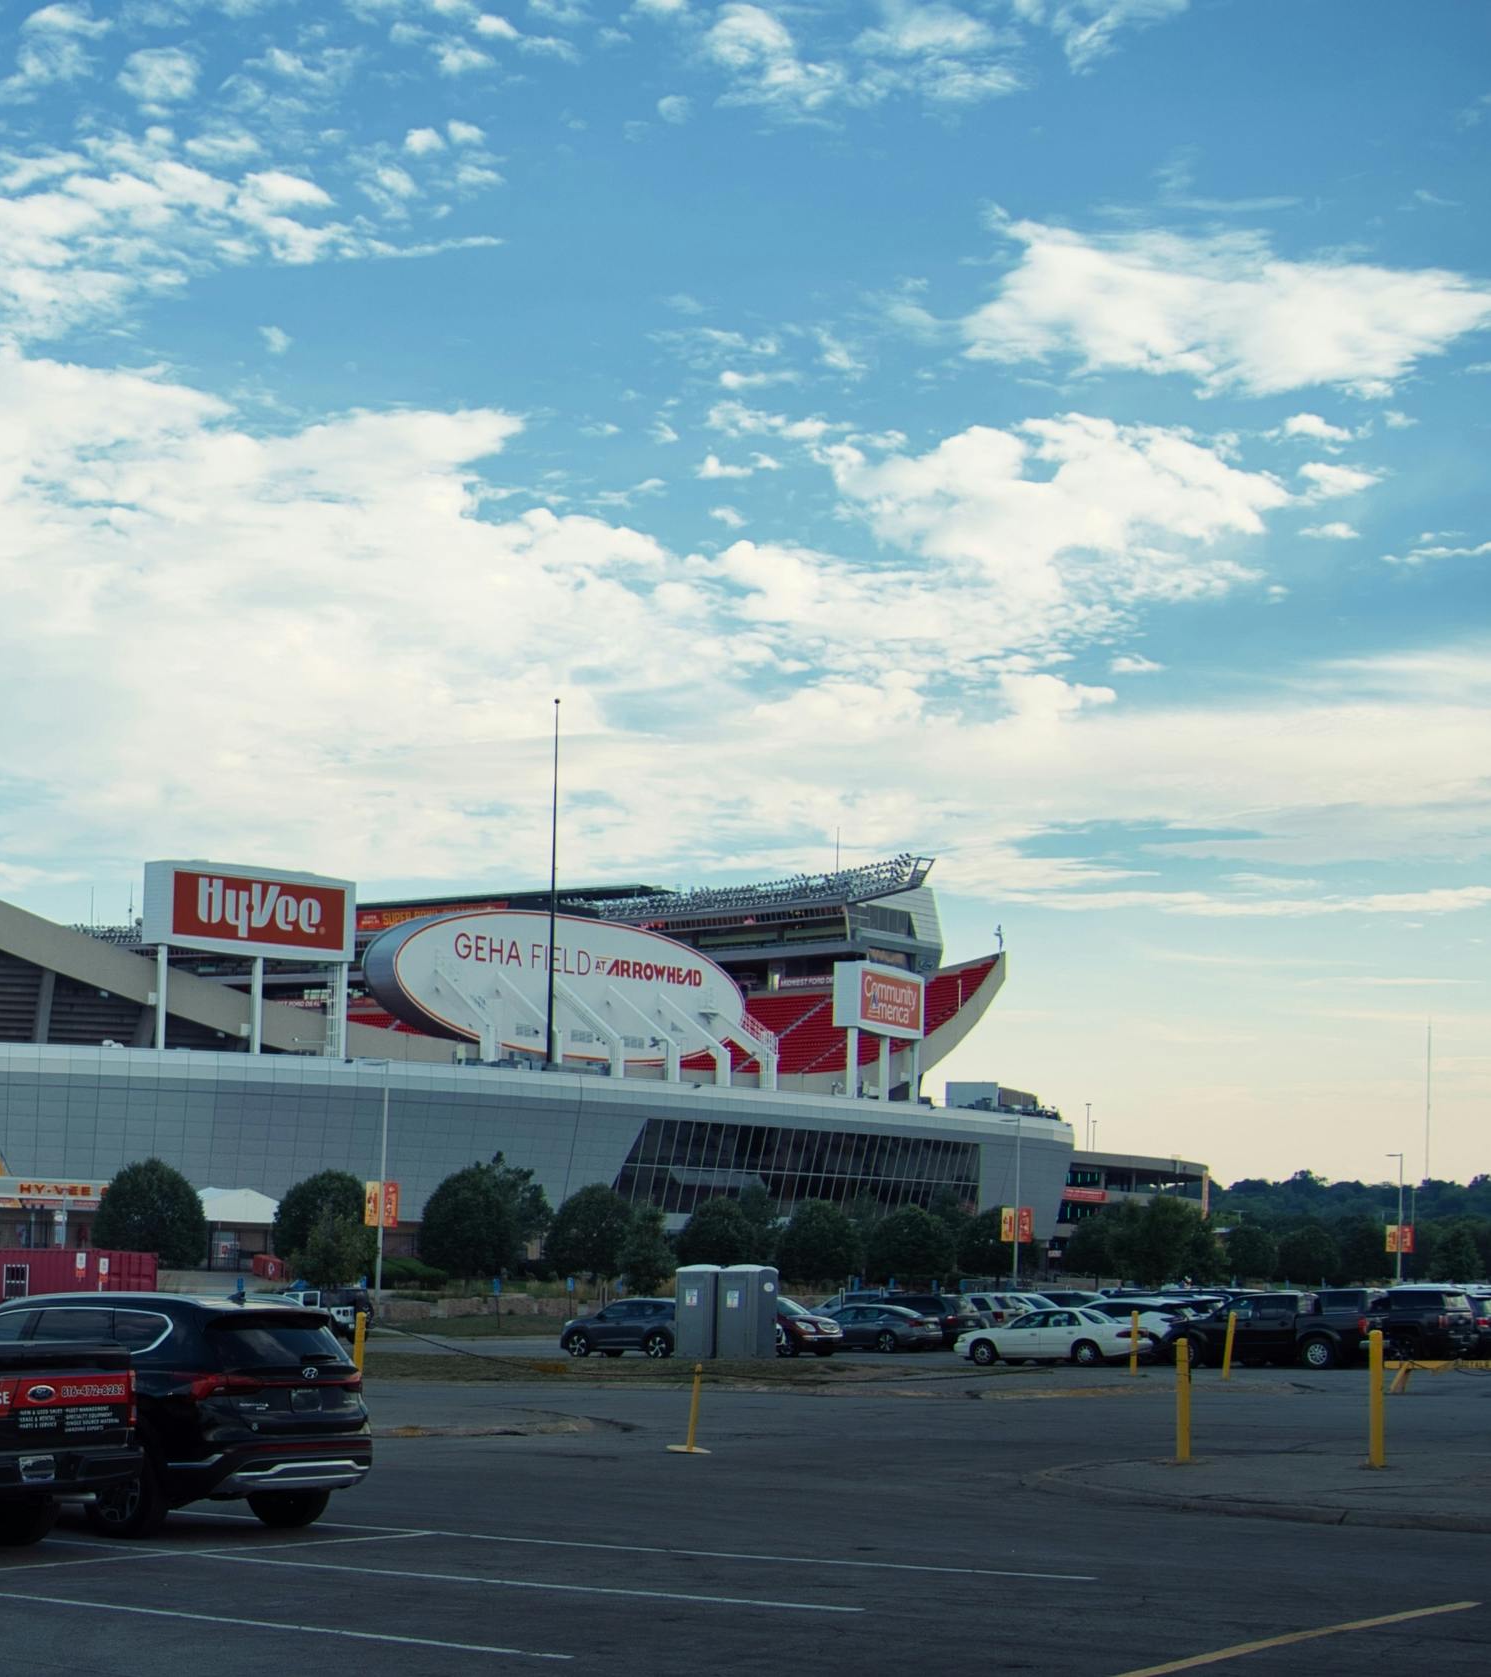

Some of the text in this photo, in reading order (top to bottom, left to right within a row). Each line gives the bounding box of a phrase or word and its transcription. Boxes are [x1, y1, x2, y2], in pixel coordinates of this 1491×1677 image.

[197, 876, 322, 938] HyVee
[454, 932, 702, 987] GEHA FIELD AT ARROWHEAD
[781, 978, 808, 987] MIDWEST
[864, 975, 917, 1010] Community
[19, 1183, 93, 1196] HY-VEE
[61, 1384, 126, 1397] 816-472-8282
